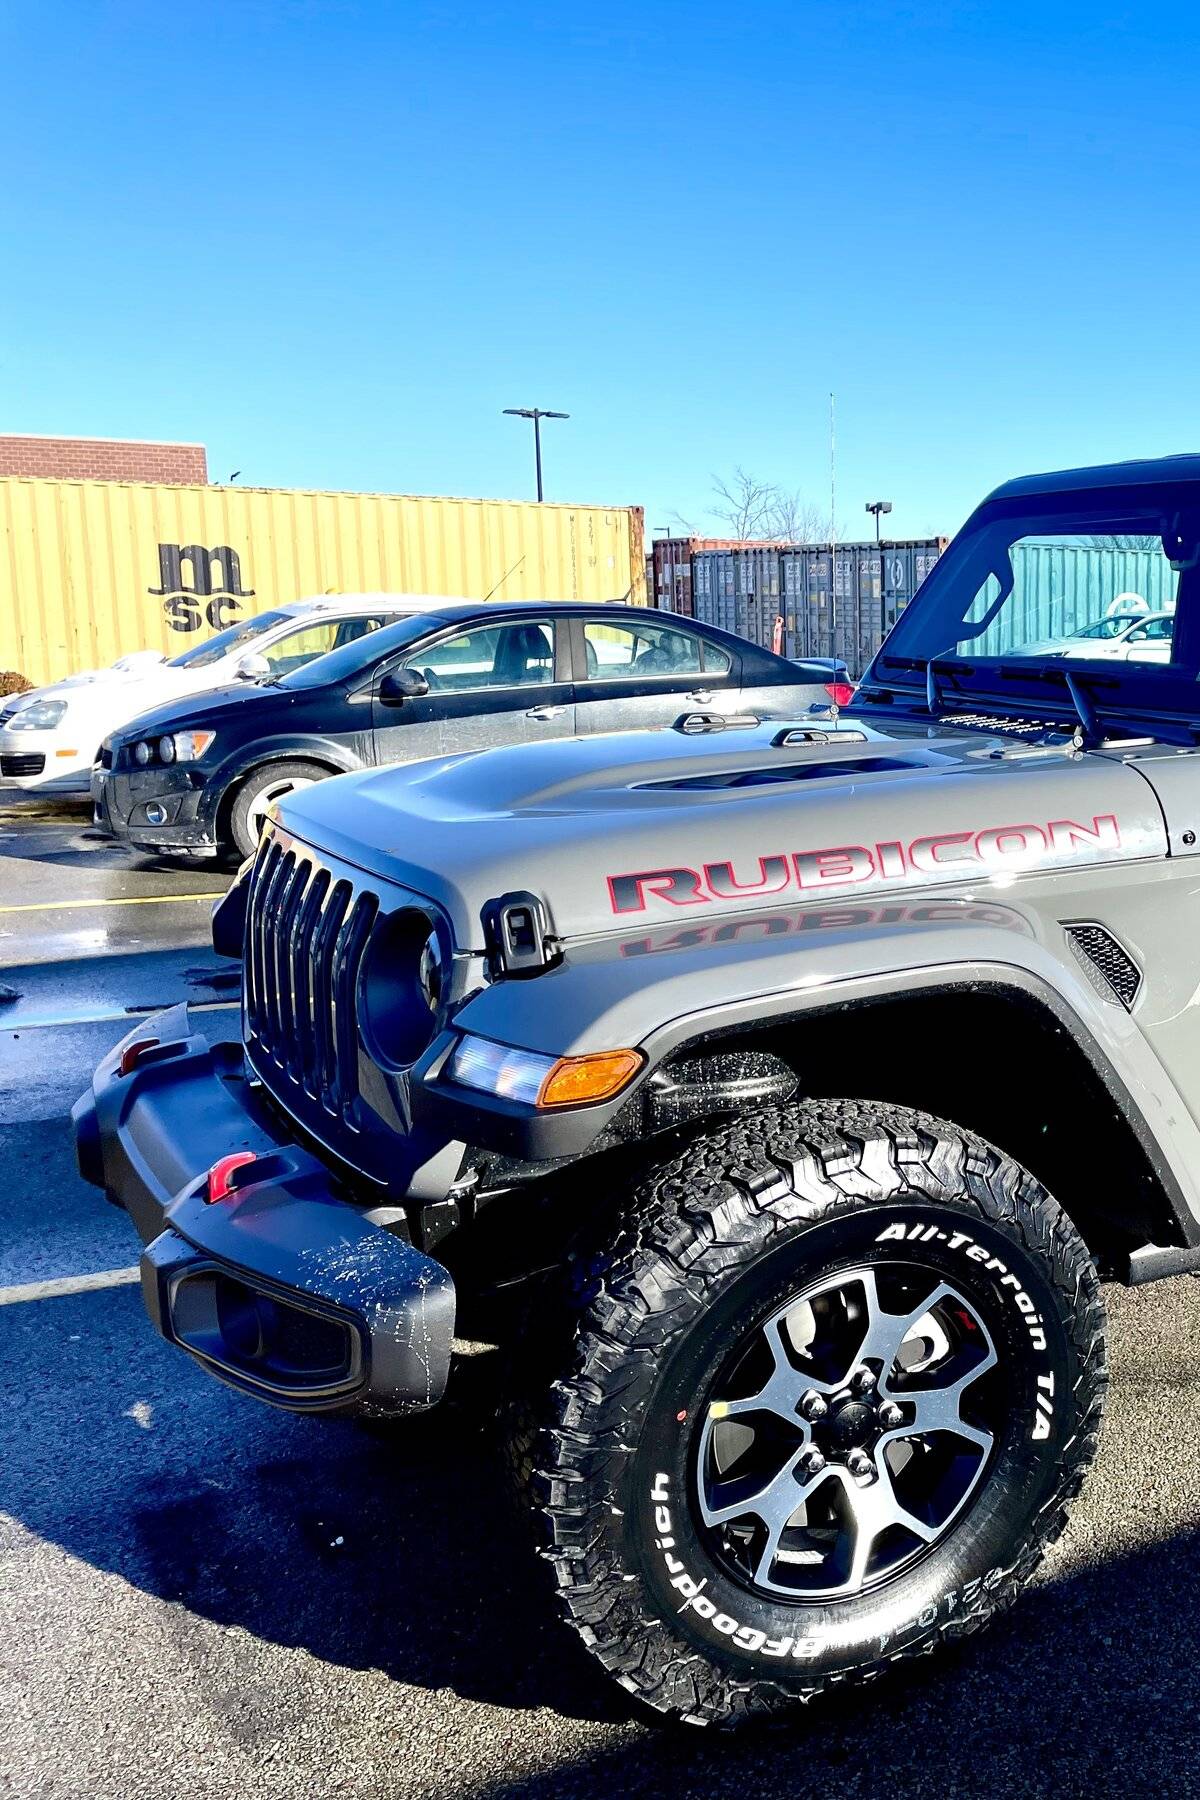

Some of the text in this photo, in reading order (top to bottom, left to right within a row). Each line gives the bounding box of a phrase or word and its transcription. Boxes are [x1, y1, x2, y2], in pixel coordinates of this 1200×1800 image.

[606, 814, 1121, 914] RUBICON
[874, 1222, 1055, 1440] All-Terrain T/A
[650, 1472, 829, 1658] BFGoodrich
